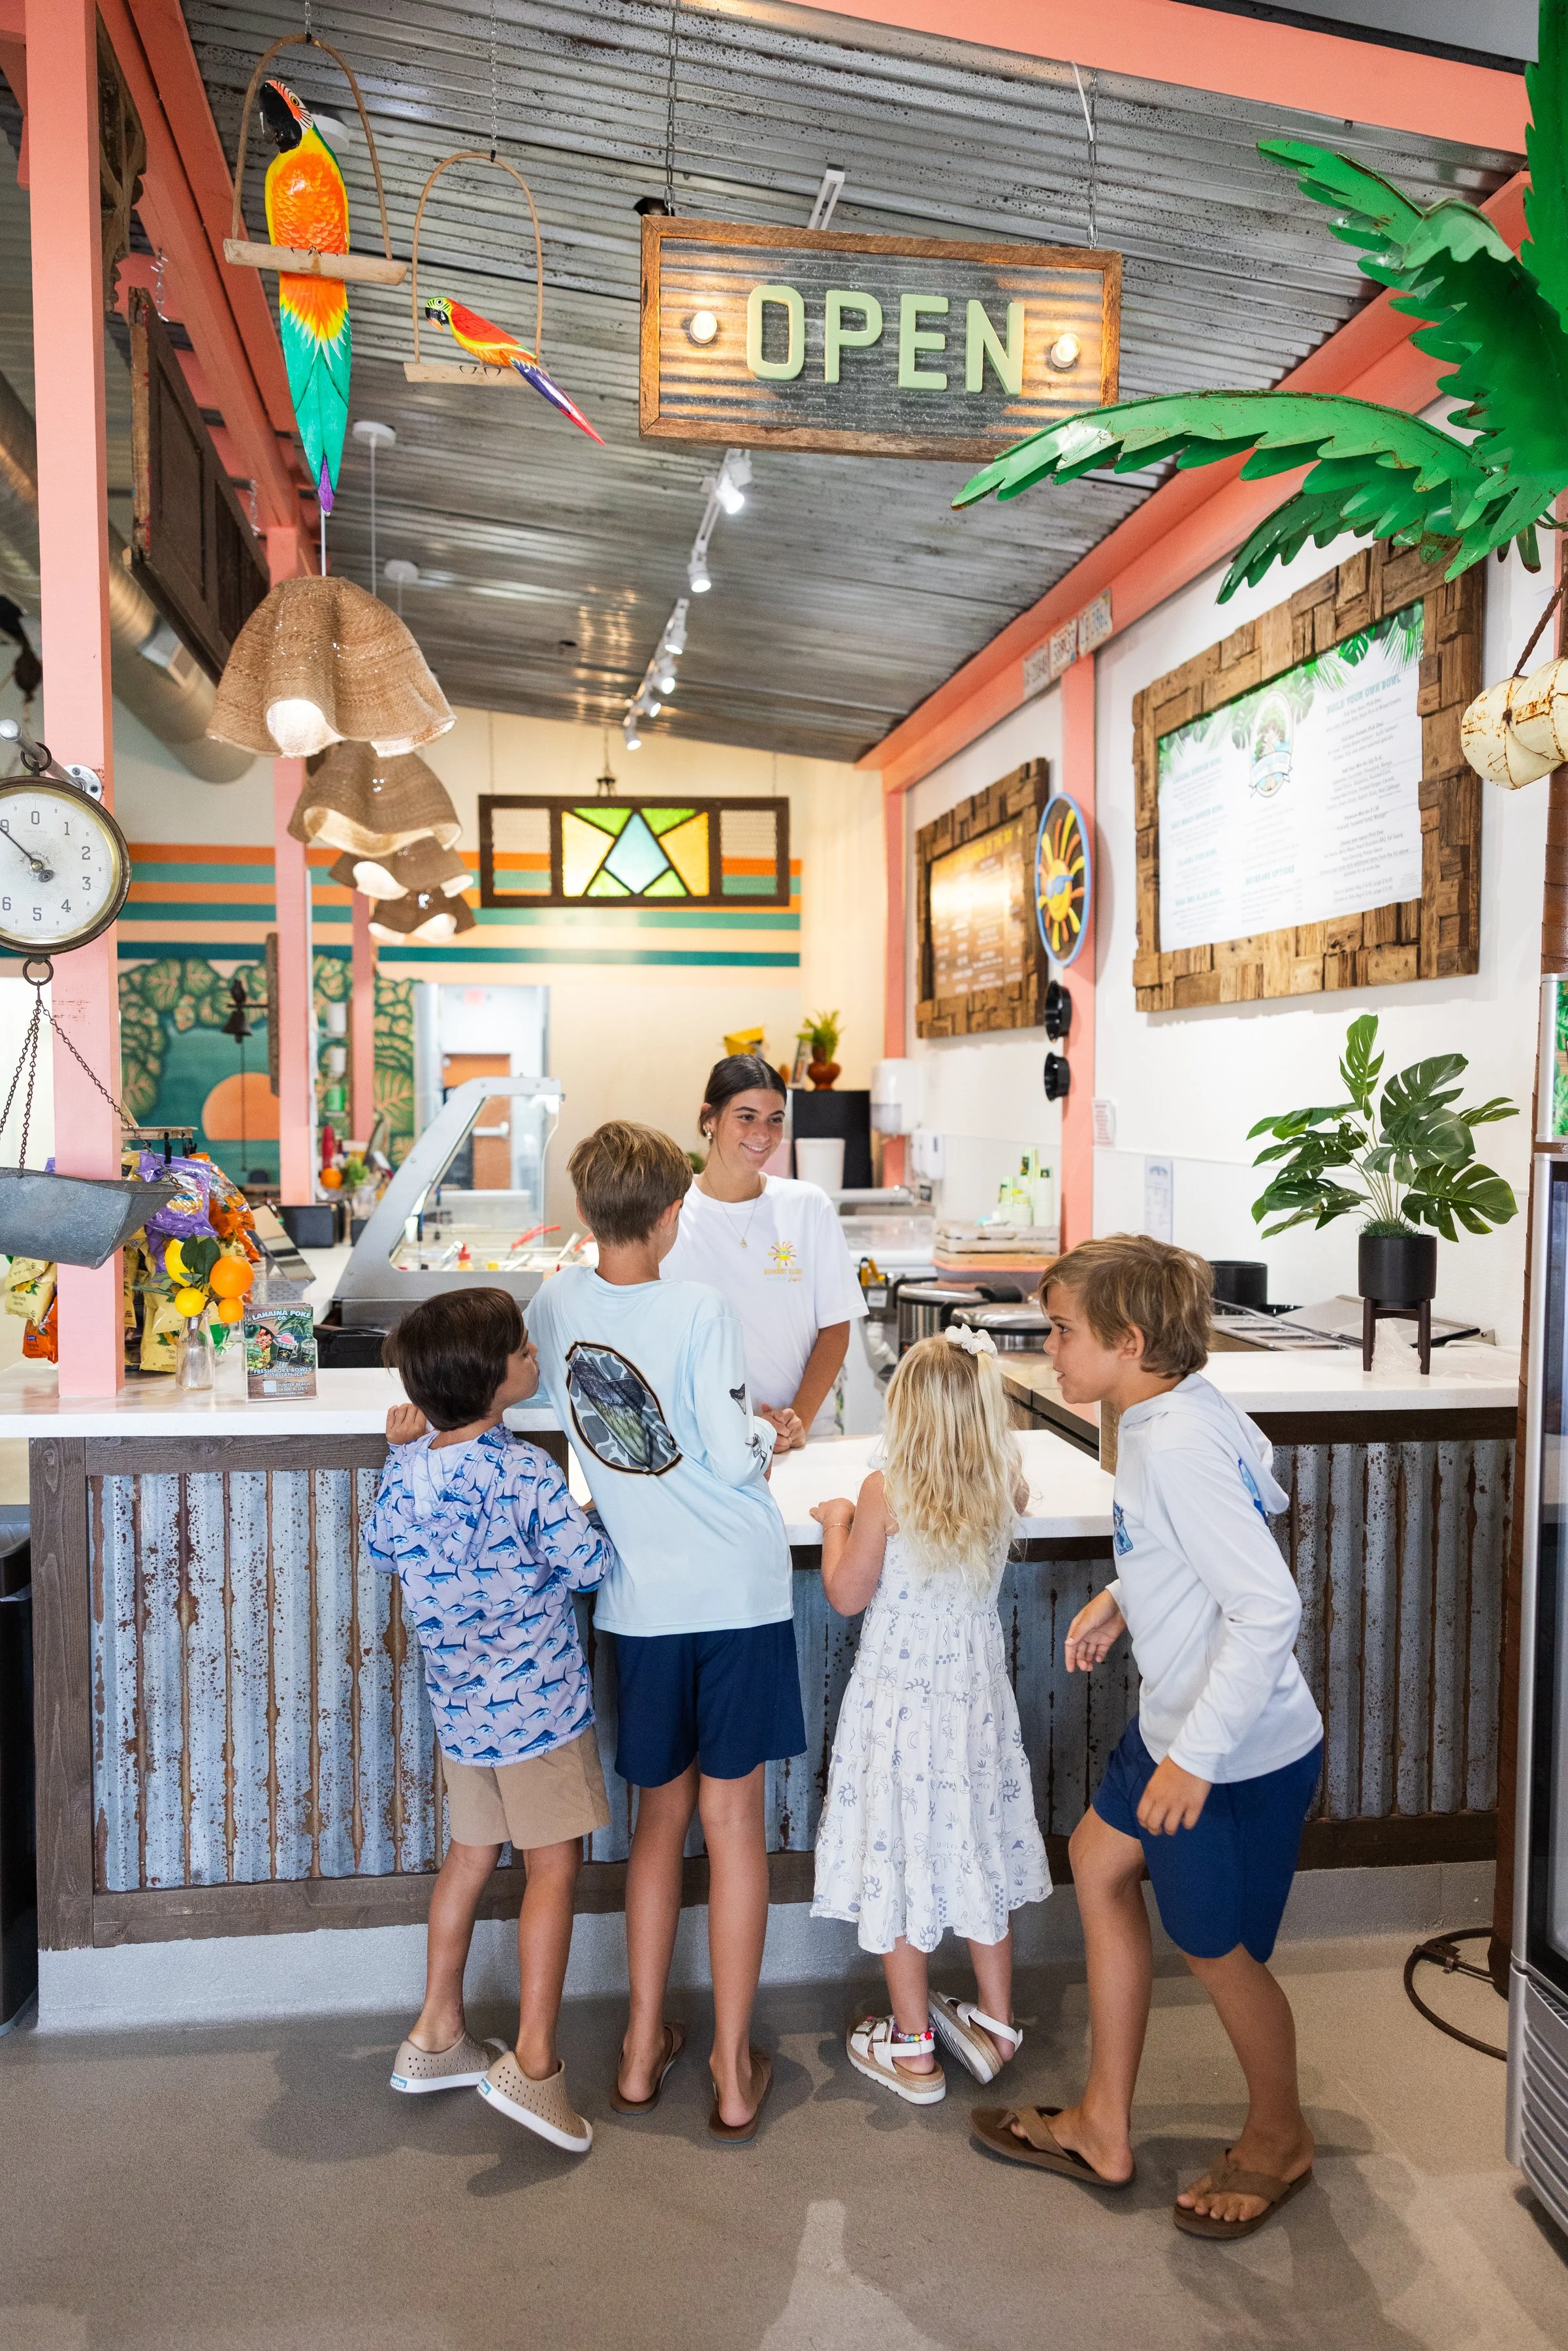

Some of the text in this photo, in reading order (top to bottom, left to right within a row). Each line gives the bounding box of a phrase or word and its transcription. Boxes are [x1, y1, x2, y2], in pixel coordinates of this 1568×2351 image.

[746, 285, 1025, 396] OPEN
[1326, 673, 1401, 715] BUILD YOUR OWN BOWL
[31, 810, 40, 825] 0
[64, 822, 71, 836] 1
[81, 846, 91, 860] 2
[82, 876, 91, 891] 3
[2, 897, 12, 910] 6
[61, 899, 71, 912] 4
[33, 907, 42, 921] 5
[252, 1310, 312, 1320] LAHAINA POKE
